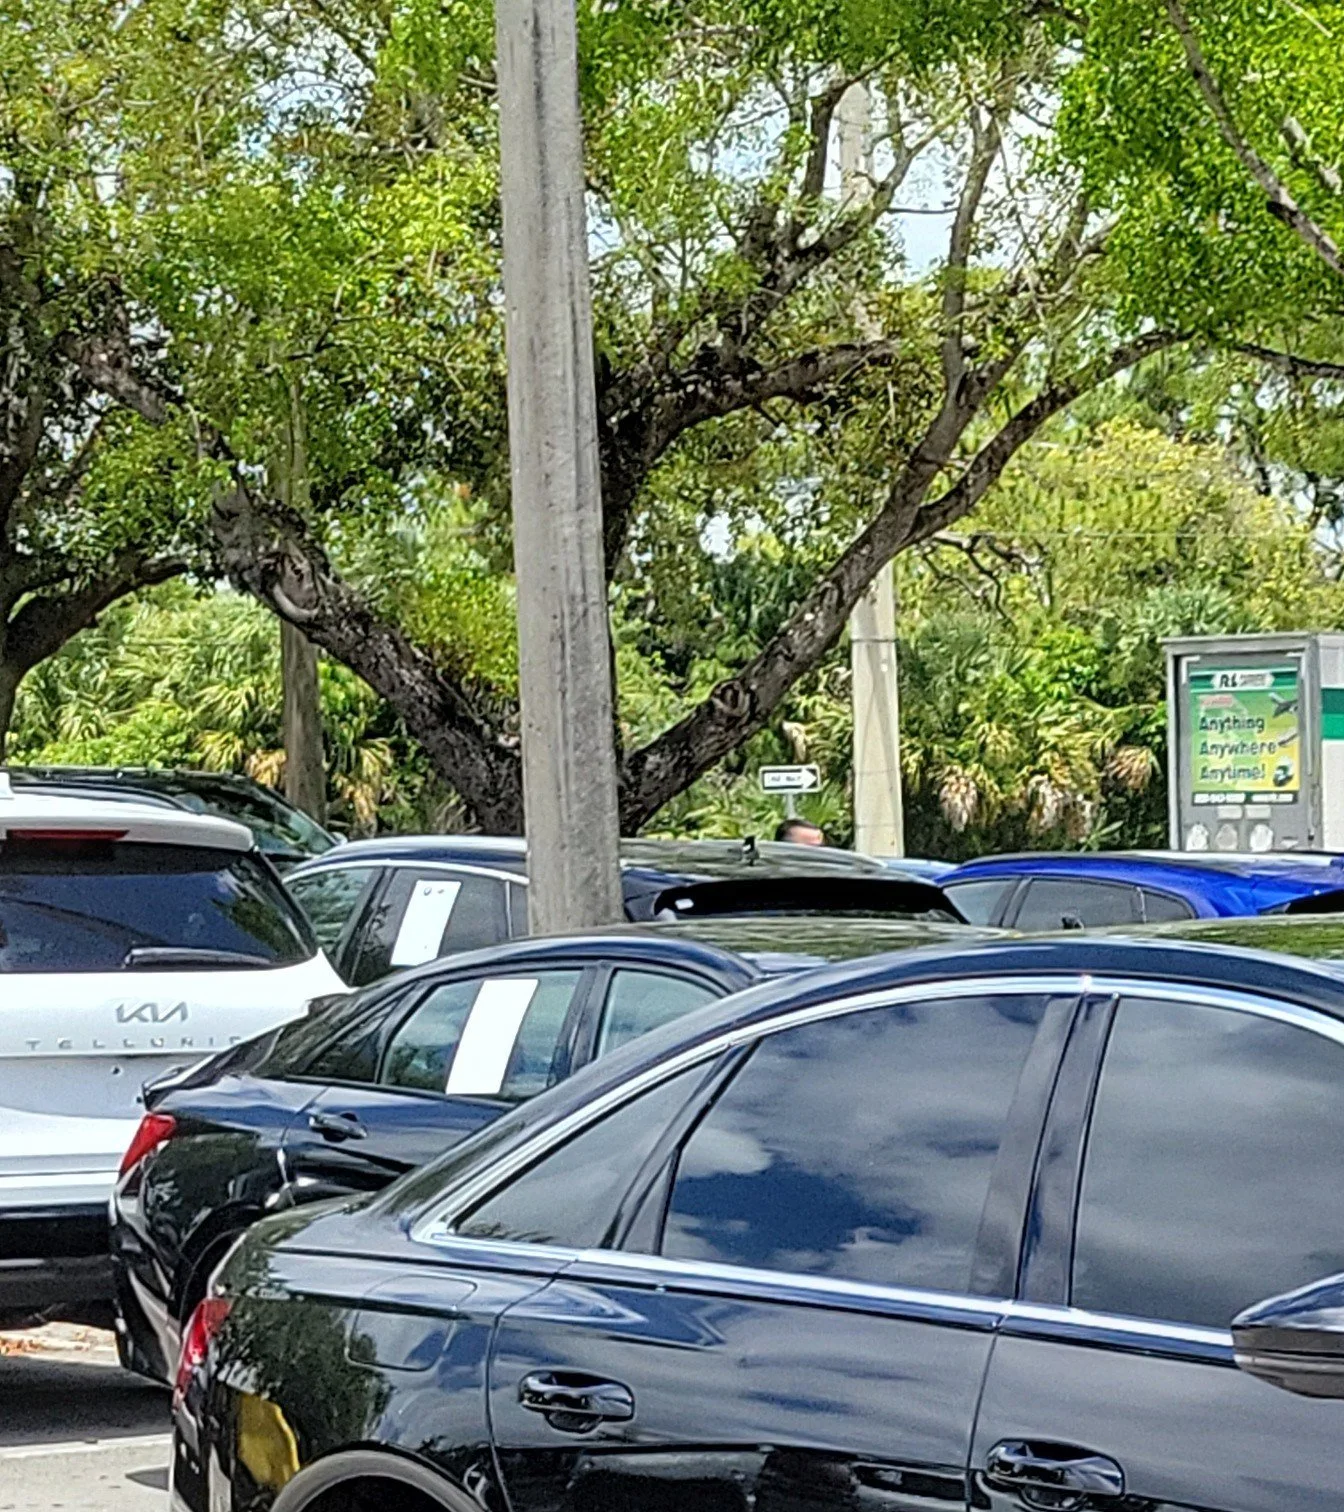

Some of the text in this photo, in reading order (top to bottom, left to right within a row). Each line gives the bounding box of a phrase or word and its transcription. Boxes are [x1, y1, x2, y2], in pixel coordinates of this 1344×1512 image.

[1200, 715, 1265, 734] Anything
[1200, 740, 1277, 758] Anywhere
[1200, 763, 1266, 782] Anytime!
